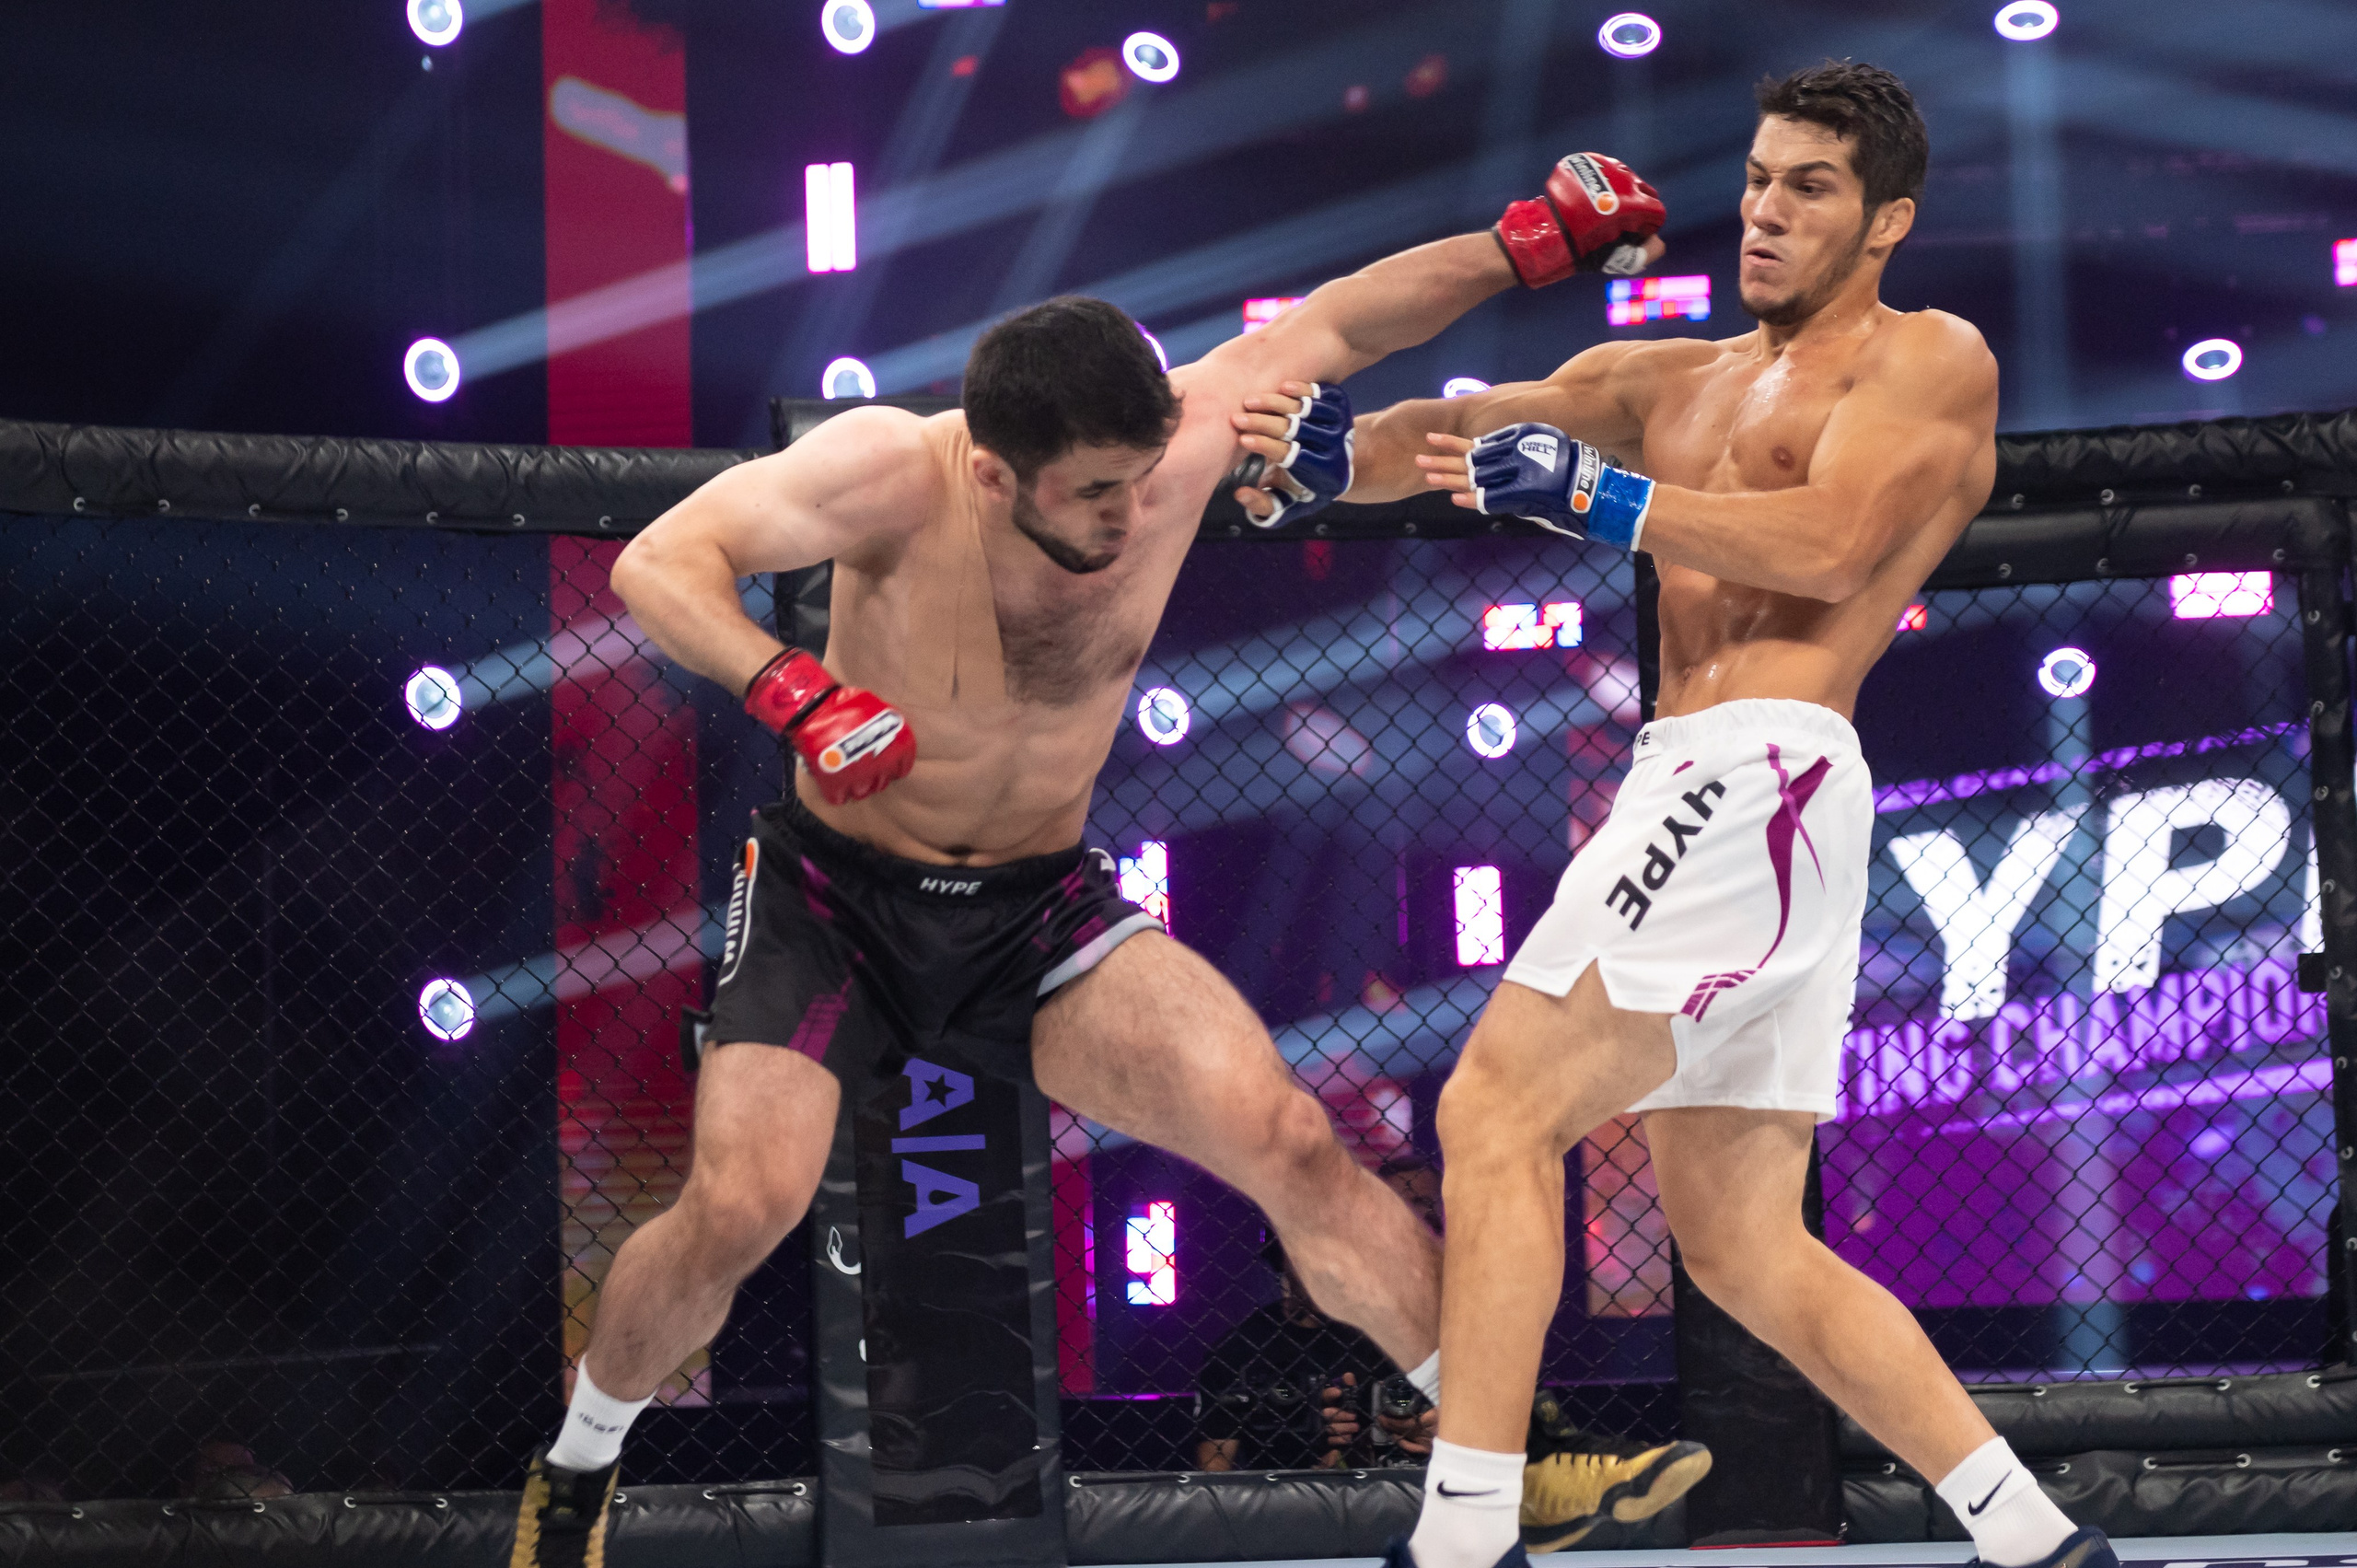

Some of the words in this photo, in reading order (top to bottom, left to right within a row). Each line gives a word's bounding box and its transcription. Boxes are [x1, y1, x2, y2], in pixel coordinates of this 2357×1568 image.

[1522, 446, 1551, 456] HILL
[920, 877, 982, 896] HYPE
[1605, 780, 1727, 932] HYPE
[1888, 777, 2325, 1022] YP
